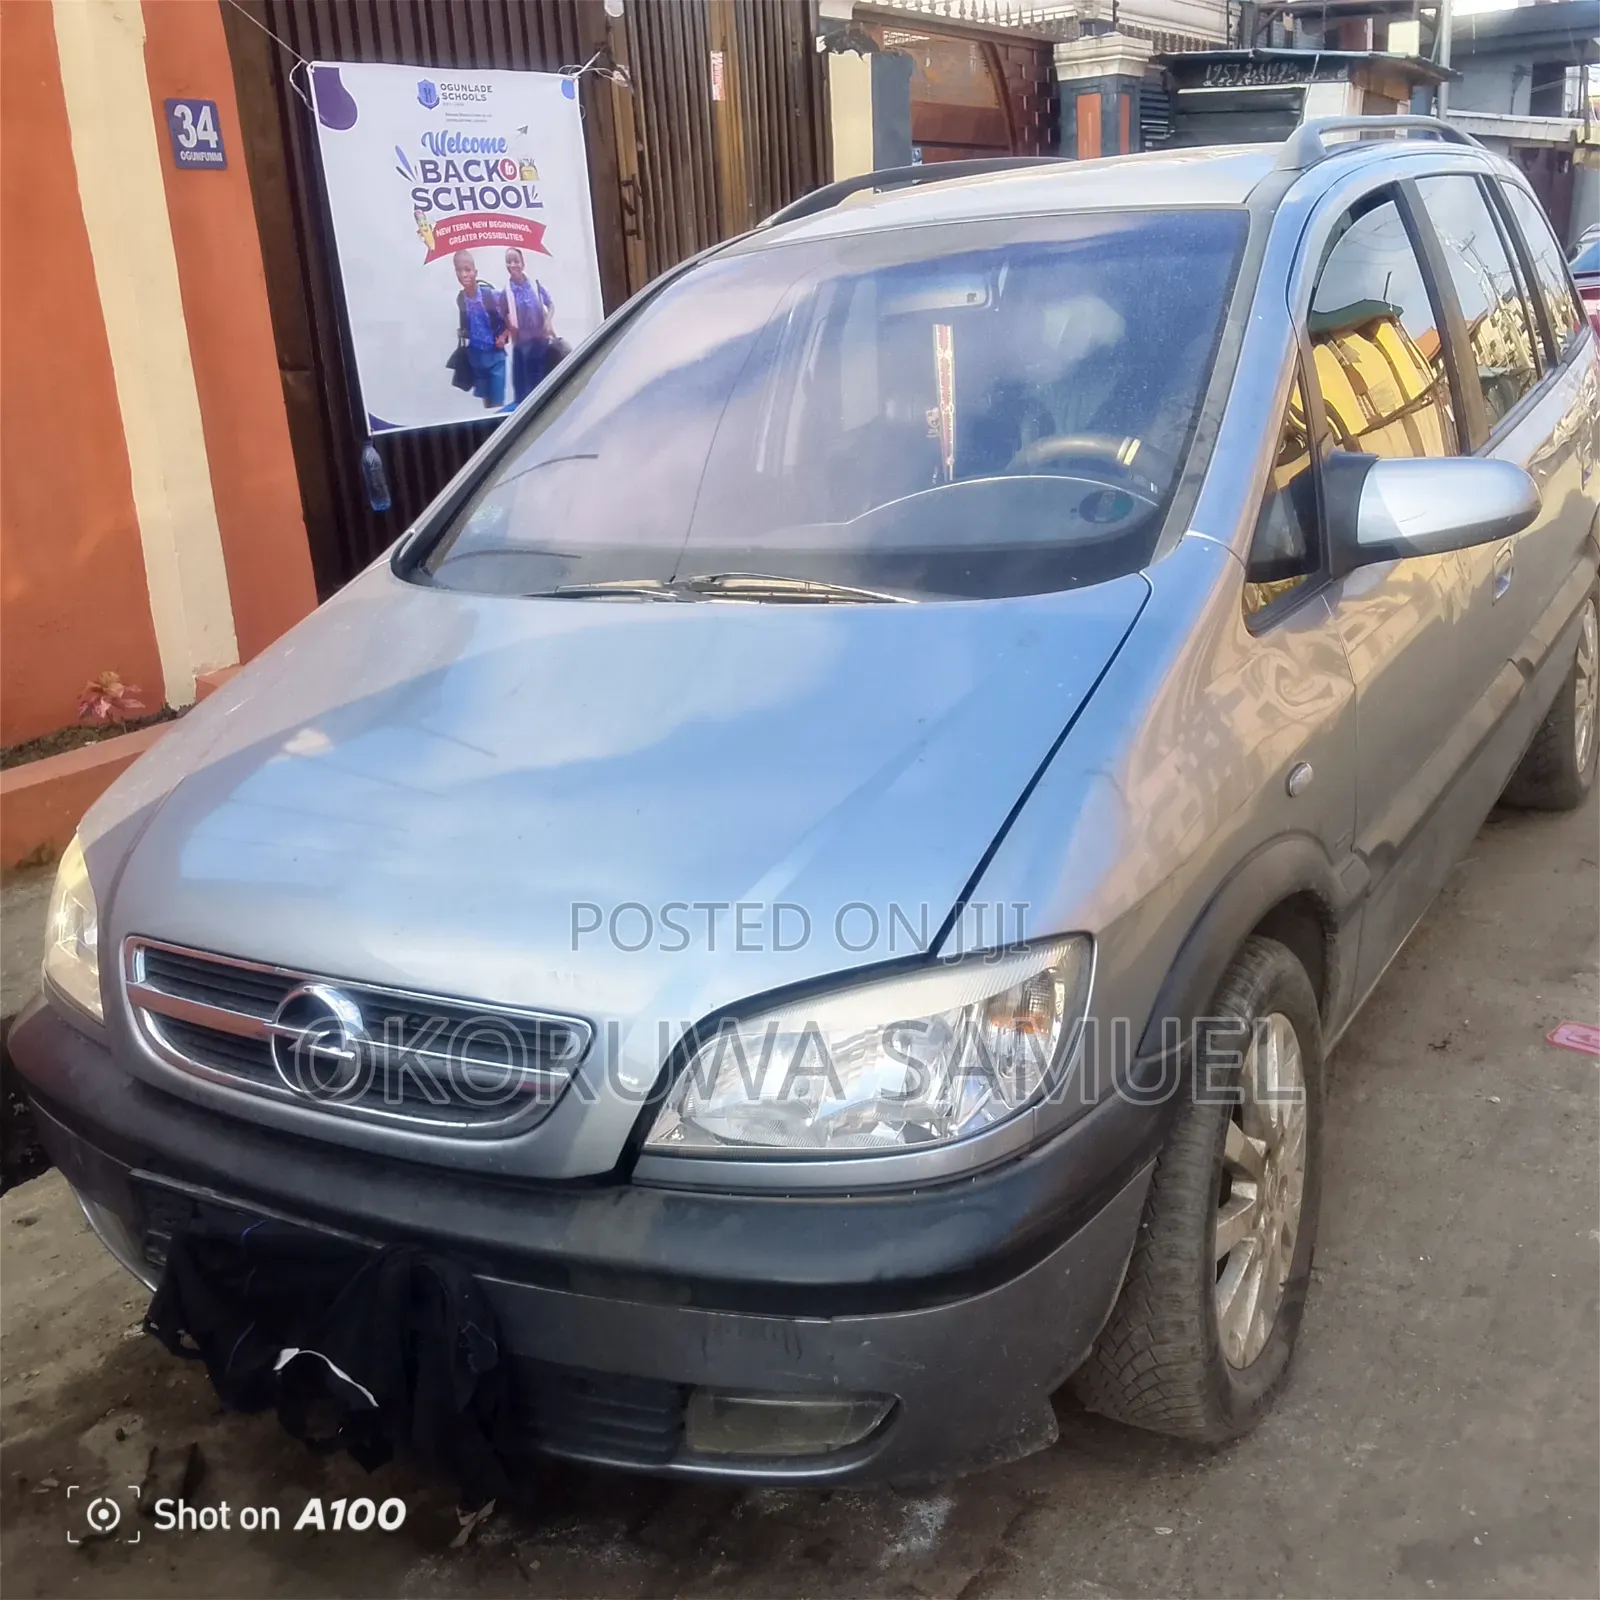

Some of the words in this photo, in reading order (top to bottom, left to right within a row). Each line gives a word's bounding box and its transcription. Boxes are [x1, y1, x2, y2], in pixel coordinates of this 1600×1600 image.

[440, 83, 493, 93] OGUNLADE
[441, 92, 487, 102] SCHOOLS
[174, 104, 218, 148] 34
[420, 129, 508, 157] Welcome
[420, 158, 508, 183] BACK
[411, 185, 544, 212] SCHOOL
[436, 226, 452, 238] NEW
[472, 221, 488, 229] NEW
[488, 220, 532, 234] BEGINNINGS,
[449, 233, 478, 245] GREATER
[478, 231, 524, 242] POSSIBILITIES
